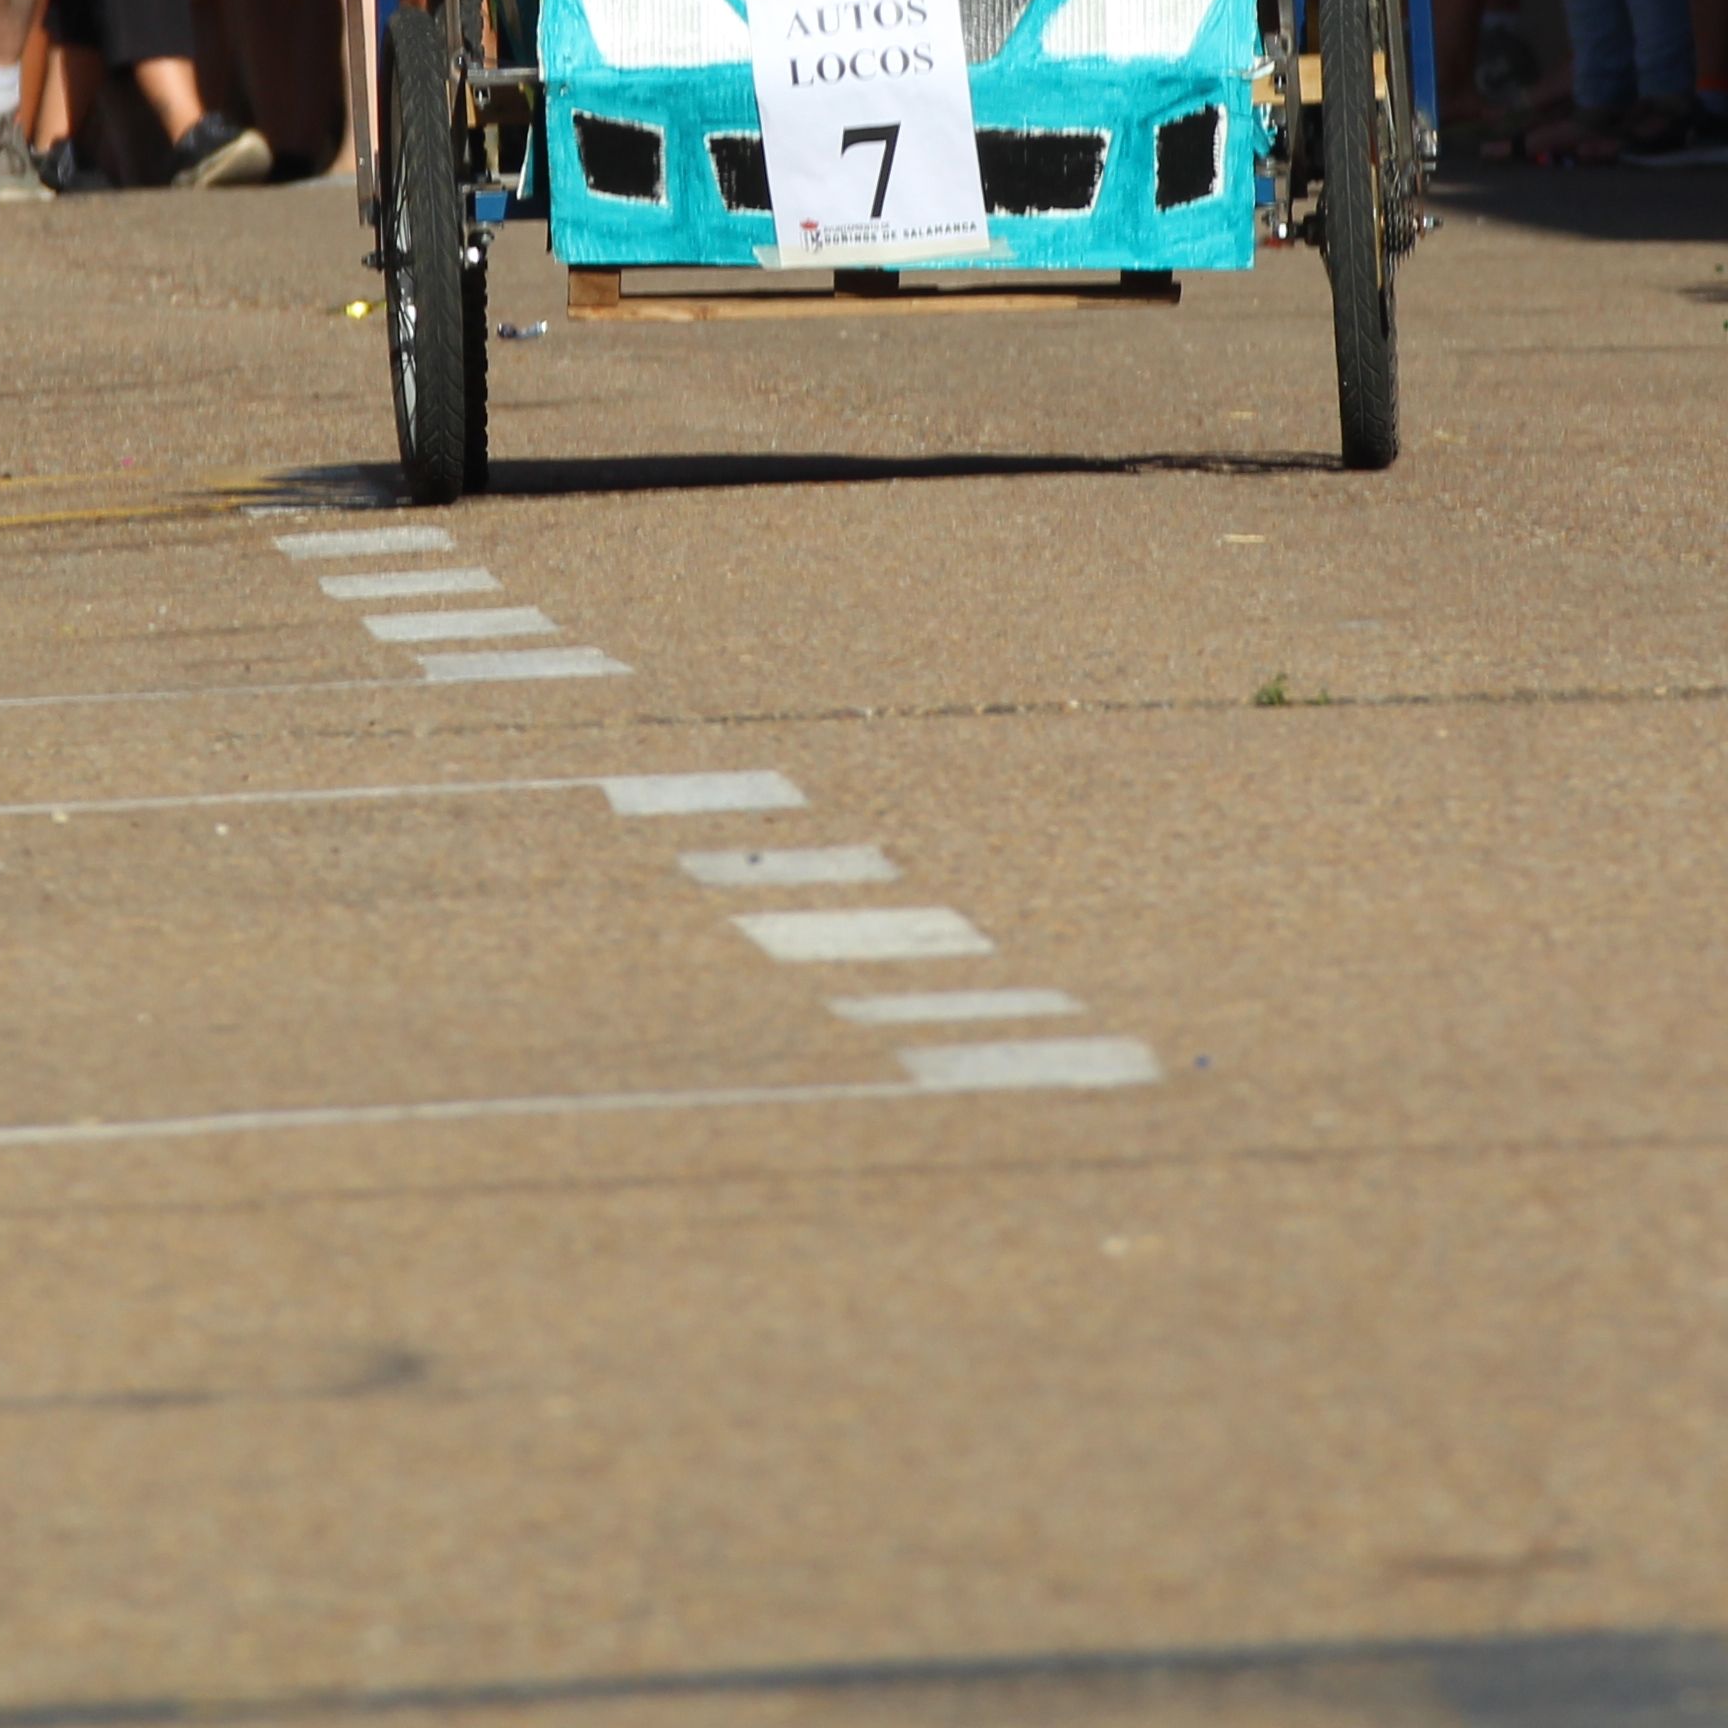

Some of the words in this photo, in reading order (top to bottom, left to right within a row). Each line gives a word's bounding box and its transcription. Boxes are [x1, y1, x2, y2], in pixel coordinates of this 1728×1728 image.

[788, 42, 934, 88] LOCOS
[841, 121, 901, 219] 7
[882, 230, 897, 242] DE
[903, 221, 977, 240] SALAMANCA
